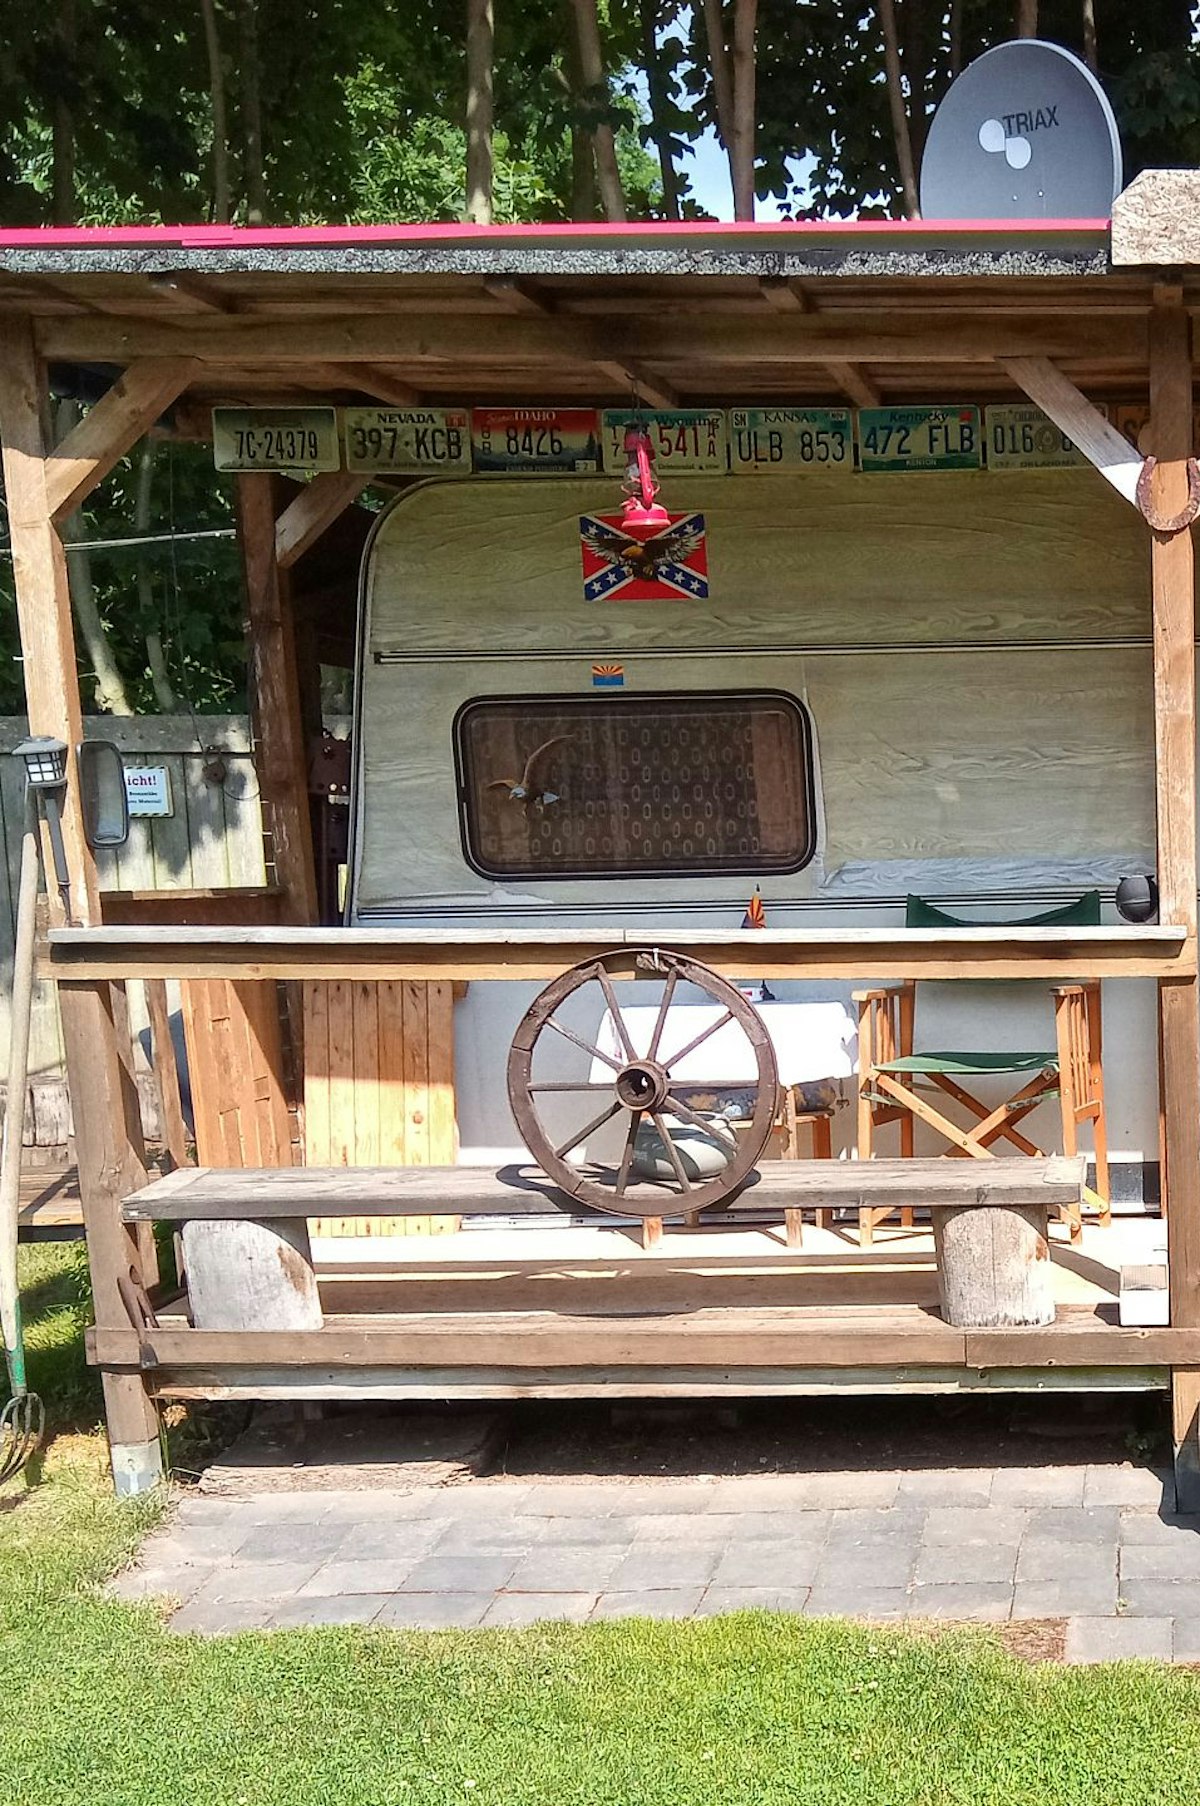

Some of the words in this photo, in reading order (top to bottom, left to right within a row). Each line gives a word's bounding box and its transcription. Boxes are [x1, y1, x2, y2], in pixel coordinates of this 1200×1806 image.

[1002, 104, 1060, 136] TRIAX
[376, 412, 436, 424] NEVADA
[514, 410, 557, 421] IDAHO
[764, 411, 818, 423] KANSAS
[889, 409, 948, 425] Kentucky
[506, 426, 563, 456] 8426
[738, 430, 784, 463] ULB
[800, 430, 846, 463] 853
[863, 424, 912, 455] 472
[928, 423, 975, 455] FLB
